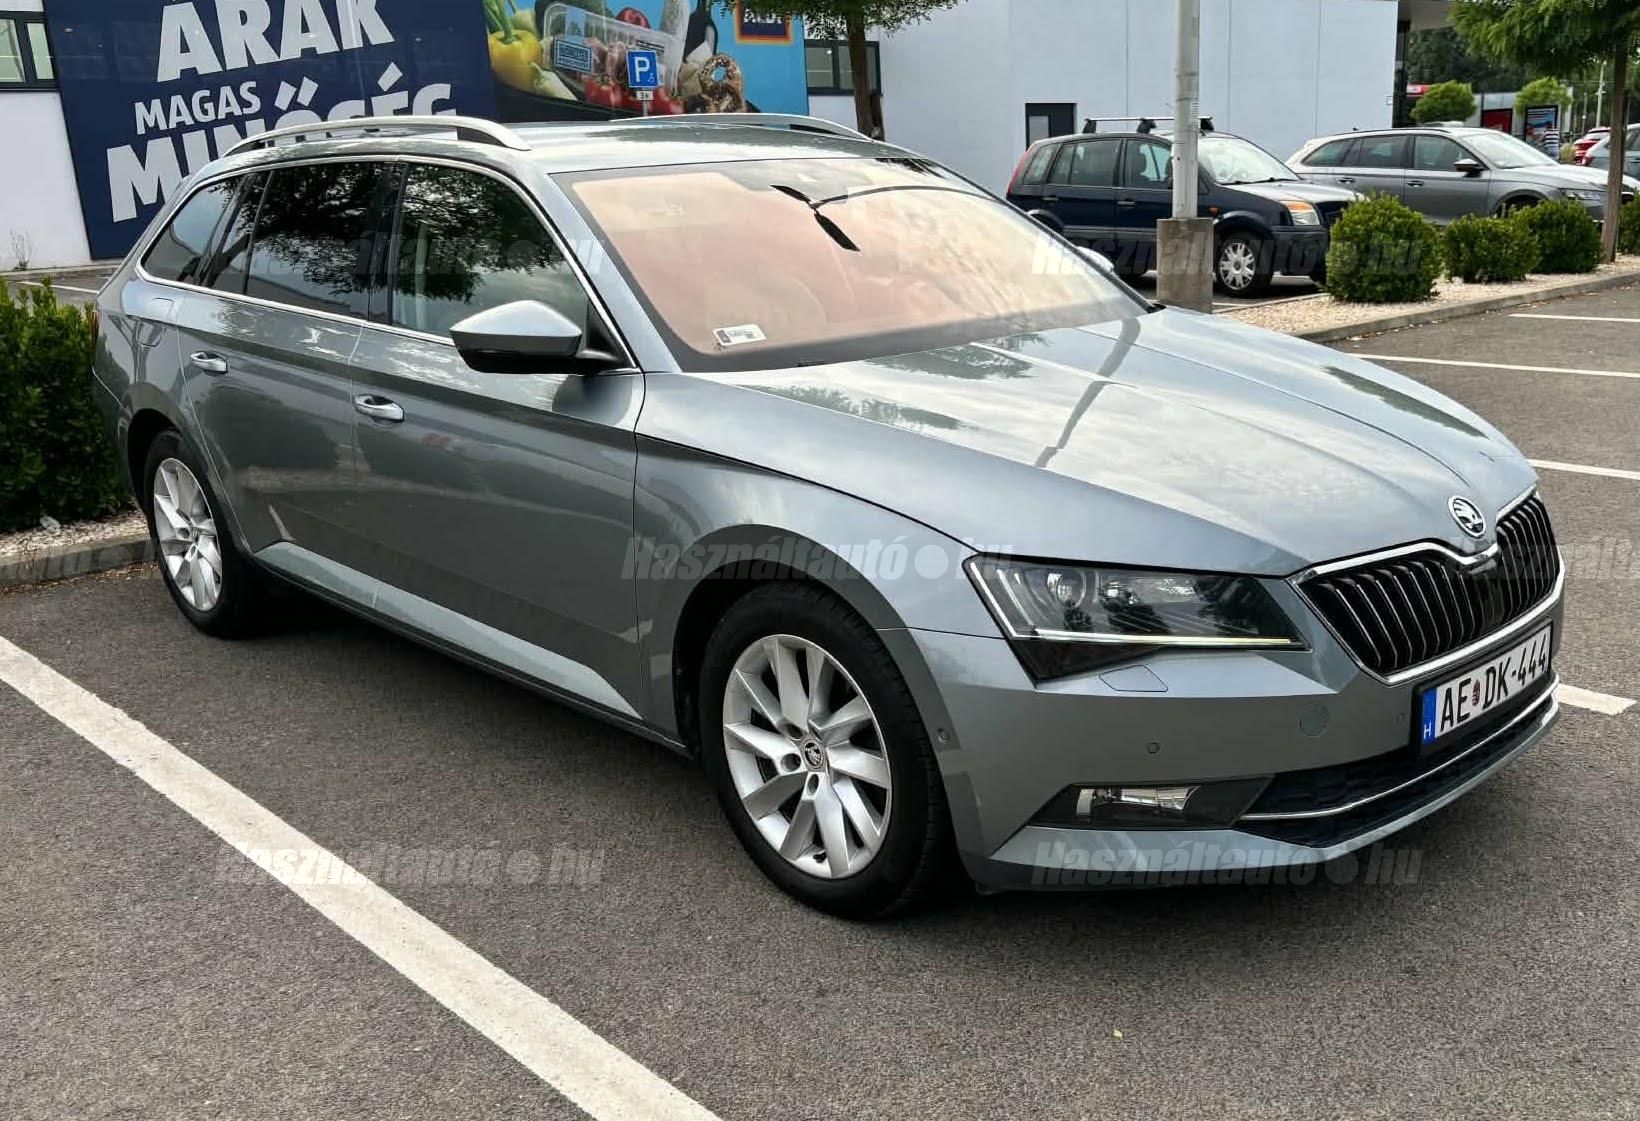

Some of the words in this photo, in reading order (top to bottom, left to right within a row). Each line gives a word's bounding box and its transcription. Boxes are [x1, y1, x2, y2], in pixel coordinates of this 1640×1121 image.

[634, 56, 650, 83] P
[134, 80, 262, 136] MAGAS
[106, 61, 458, 223] MIŐÉG
[1440, 677, 1472, 732] AE
[1482, 633, 1546, 710] DK-444
[1423, 721, 1432, 740] H
